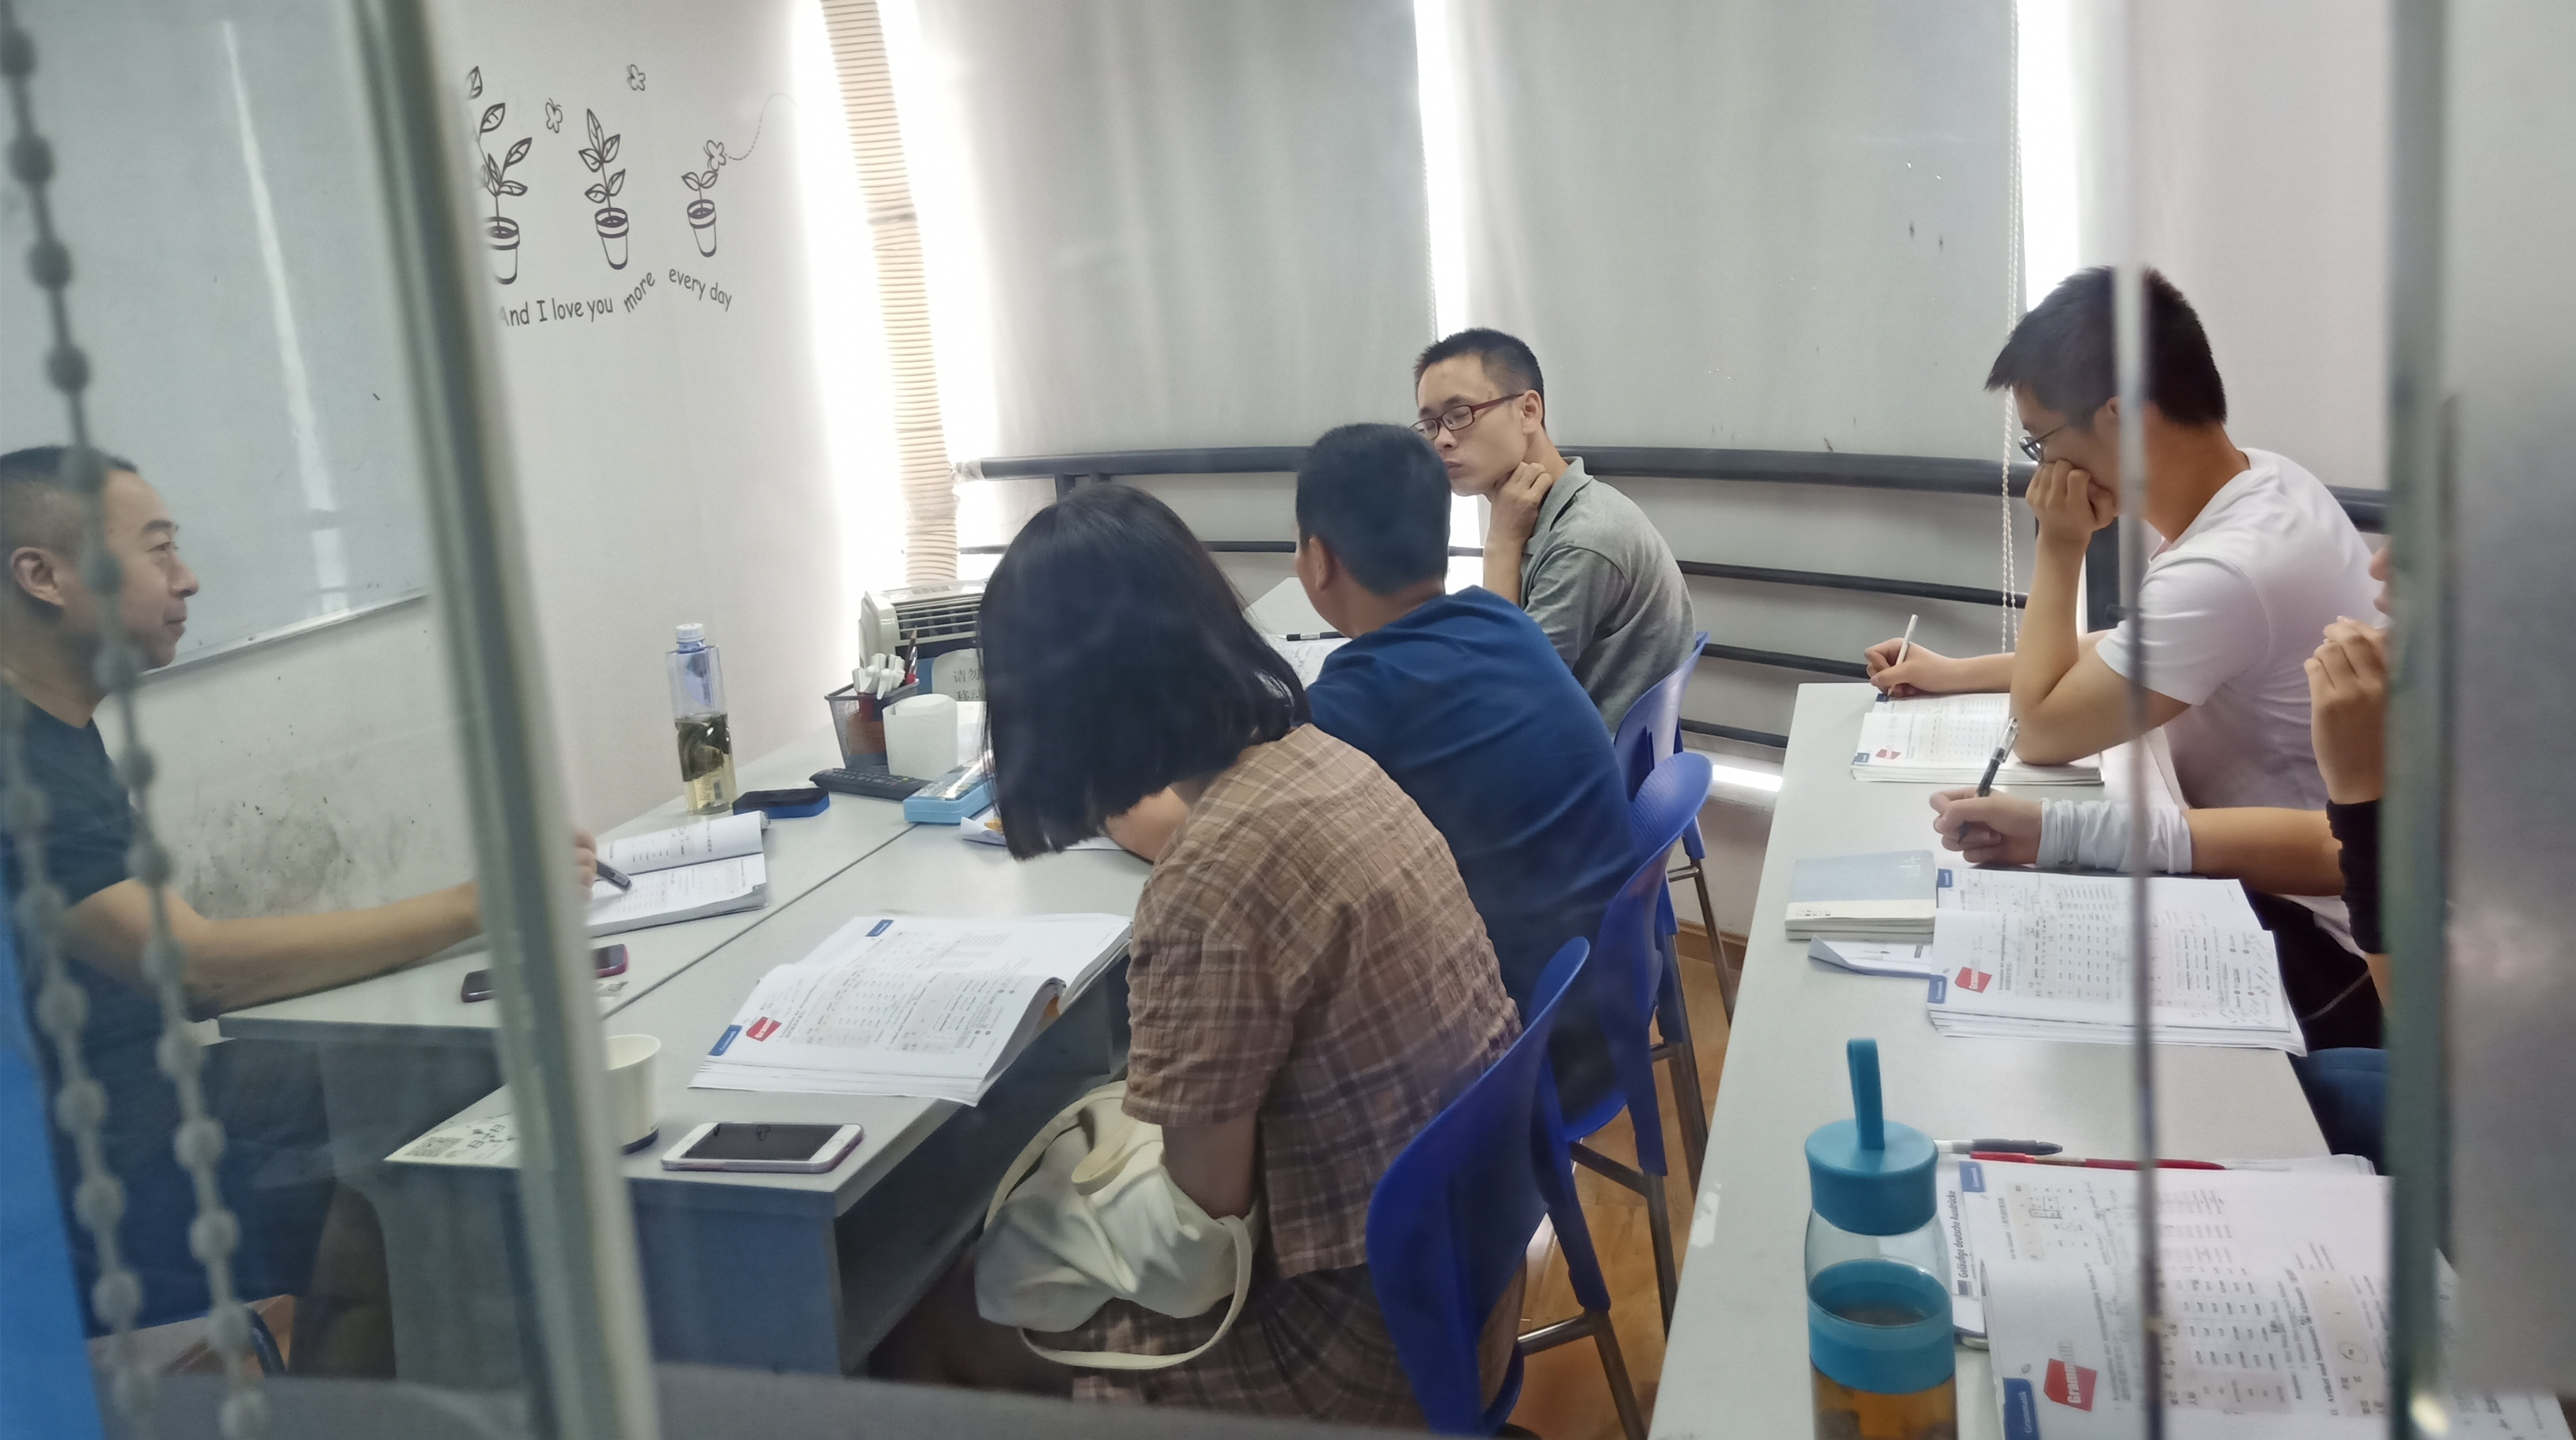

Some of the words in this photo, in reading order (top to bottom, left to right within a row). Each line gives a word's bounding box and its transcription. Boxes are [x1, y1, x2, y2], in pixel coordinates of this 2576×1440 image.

[499, 301, 530, 327] And
[536, 300, 548, 322] I
[551, 297, 584, 320] love
[586, 298, 613, 323] you
[624, 272, 655, 313] more
[669, 268, 706, 301] every
[710, 282, 732, 312] day
[953, 668, 980, 683] 请勿
[1947, 1190, 1959, 1221] Ausdrücke
[1950, 1221, 1963, 1248] deutsche
[1953, 1249, 1968, 1278] Geläufige
[2018, 1390, 2032, 1434] Grammatik
